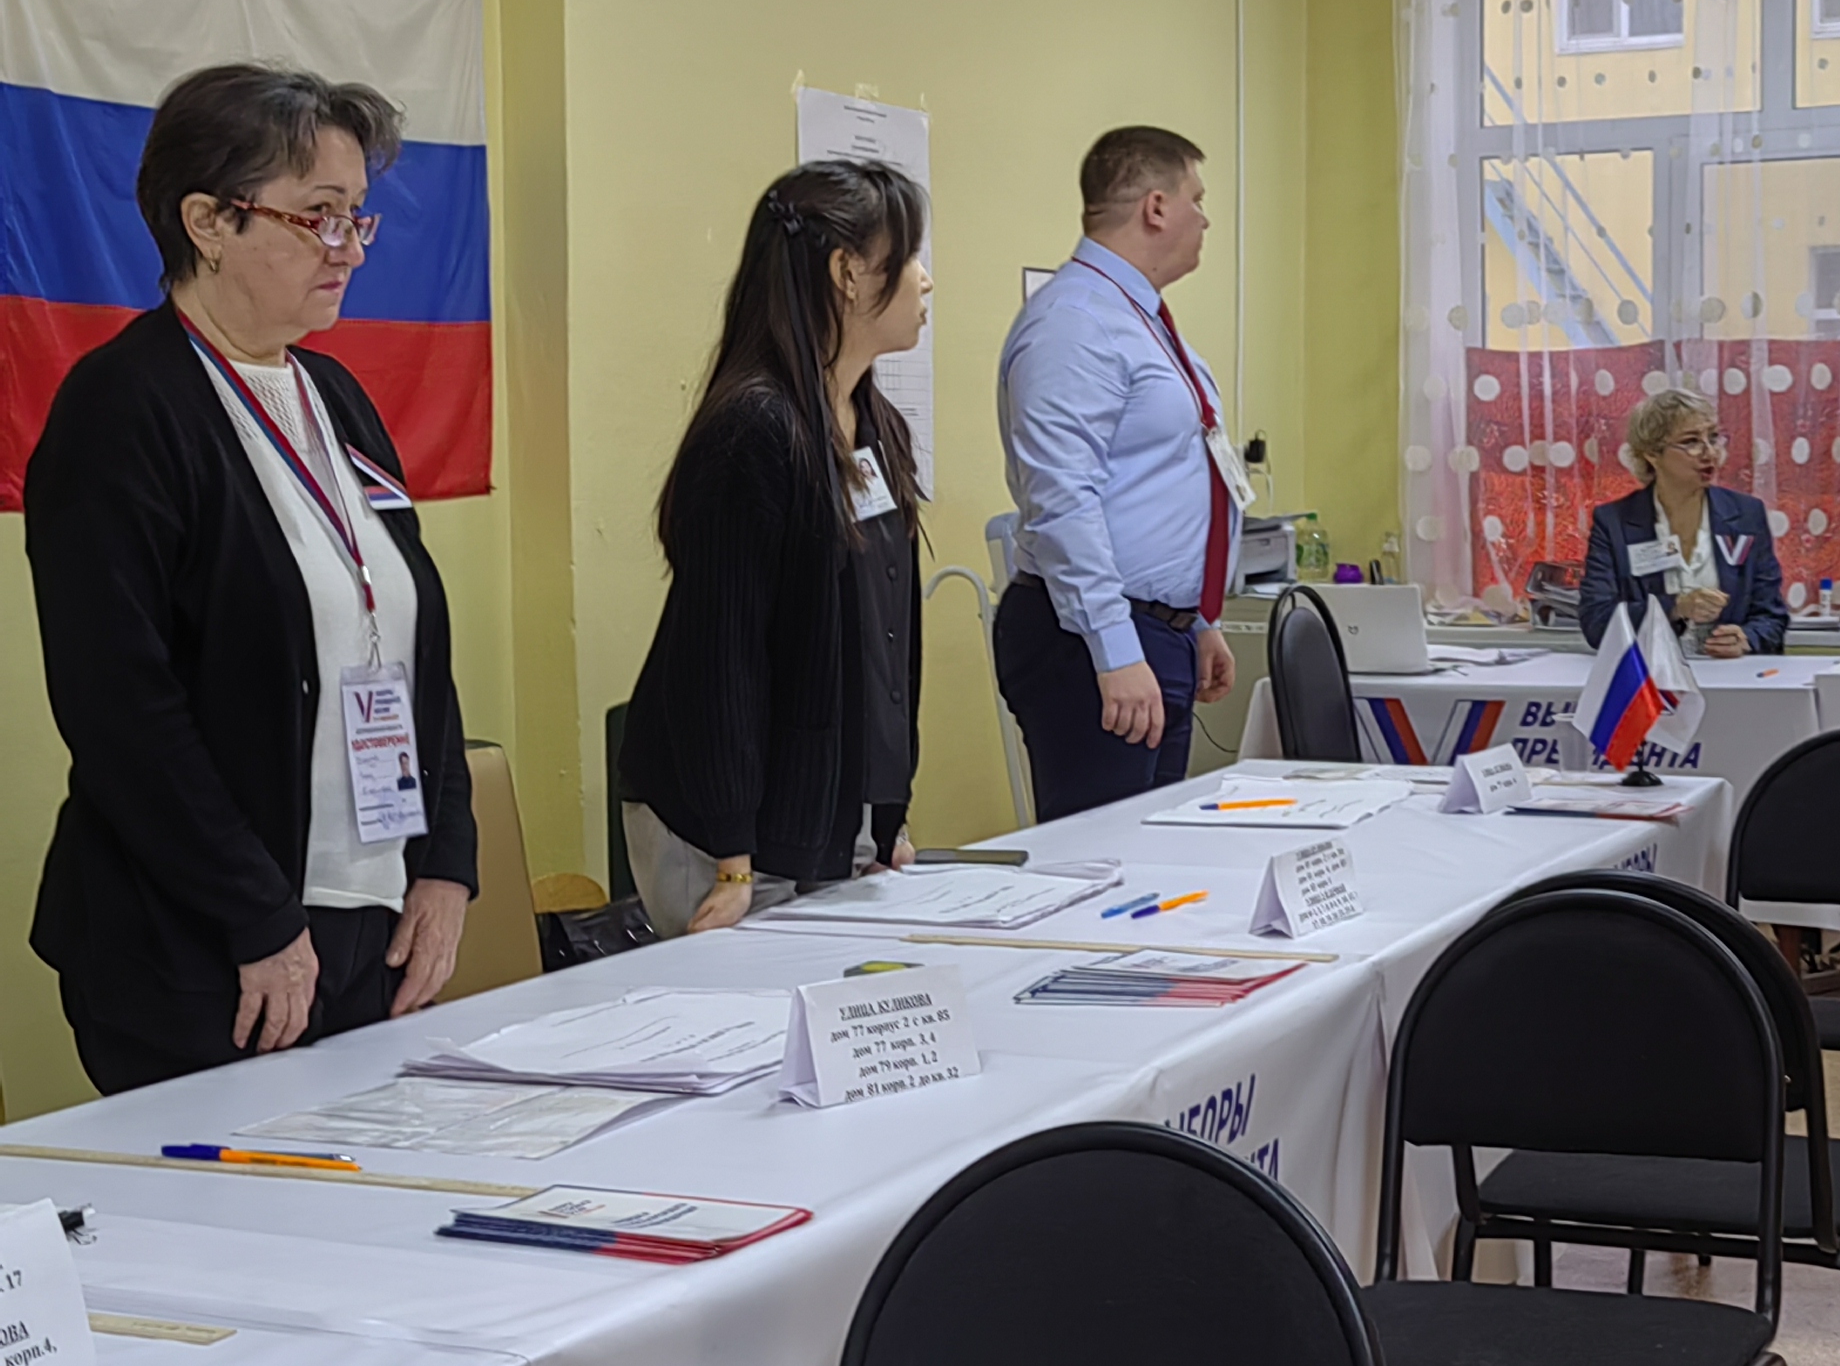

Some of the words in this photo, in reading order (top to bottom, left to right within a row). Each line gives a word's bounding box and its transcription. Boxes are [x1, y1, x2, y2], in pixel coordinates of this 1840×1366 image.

[839, 1002, 877, 1021] УЛИЦА
[877, 993, 933, 1014] КУЛИКОВА
[851, 1024, 864, 1037] 77
[902, 1016, 909, 1028] 2
[874, 1040, 887, 1053] 77
[931, 1050, 938, 1063] 2
[6, 1269, 22, 1290] 17
